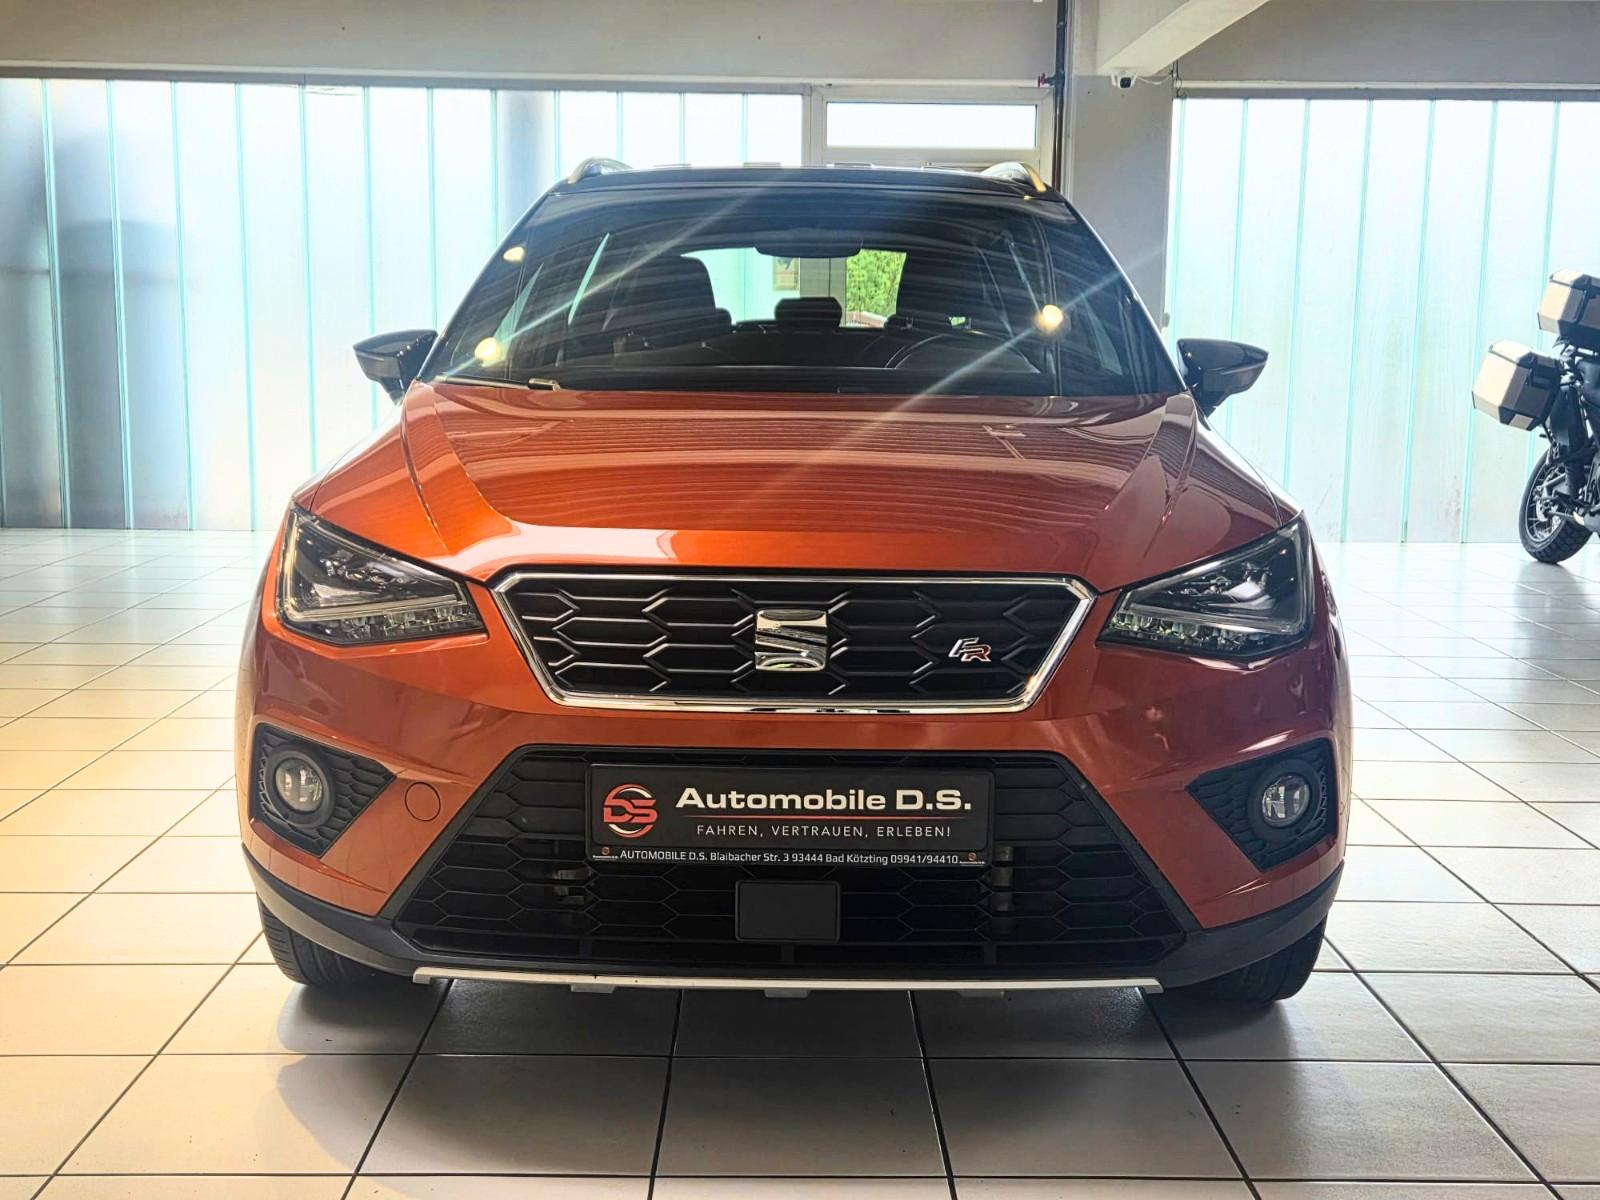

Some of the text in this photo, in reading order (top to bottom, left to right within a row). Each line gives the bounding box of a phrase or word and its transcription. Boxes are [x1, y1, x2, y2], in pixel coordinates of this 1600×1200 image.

[948, 637, 992, 662] FR
[675, 787, 972, 811] Automobile D.S.
[696, 825, 951, 839] FAHREN, VERTRAUEN, ERLEBEN!
[619, 849, 686, 860] AUTOMOBILE
[688, 851, 708, 861] D.S.
[710, 852, 761, 862] Blaibacher
[763, 853, 781, 862] Str.
[783, 853, 789, 862] 3
[791, 853, 823, 862] 93444
[825, 853, 844, 863] Bad
[846, 853, 889, 866] Kötzting
[890, 854, 959, 864] 09941/94410
